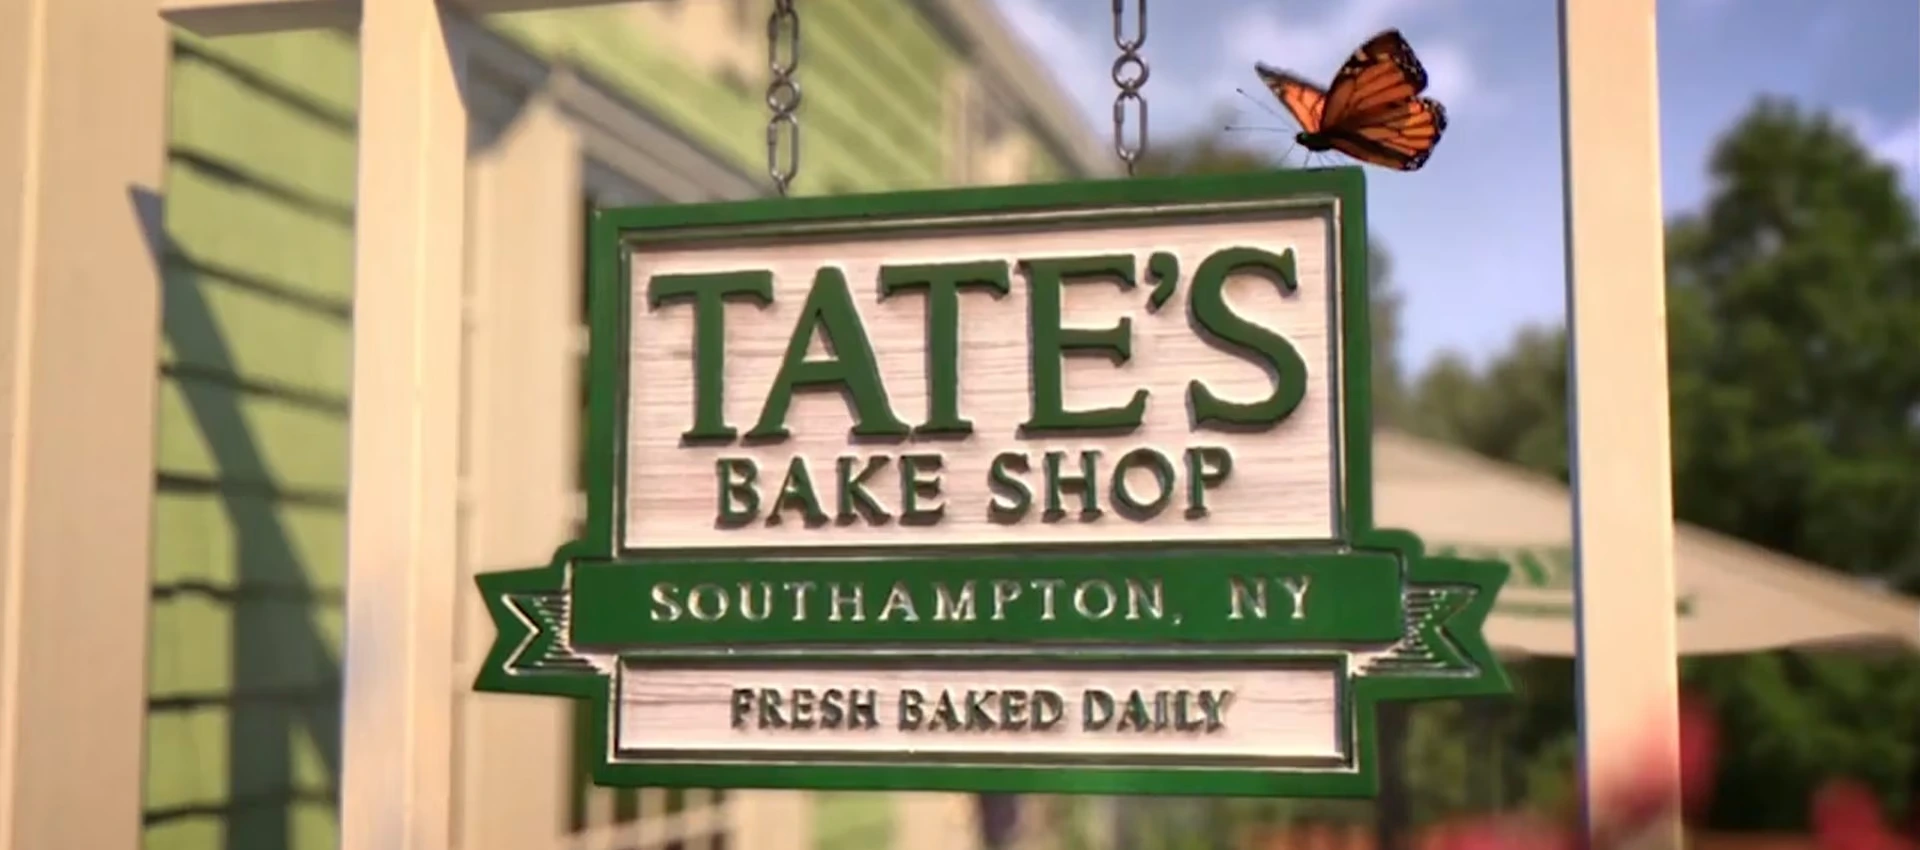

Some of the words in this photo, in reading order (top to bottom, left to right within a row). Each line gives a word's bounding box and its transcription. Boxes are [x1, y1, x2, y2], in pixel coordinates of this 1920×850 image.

[647, 246, 1308, 447] TATE'S
[714, 454, 946, 529] BAKE
[988, 445, 1232, 524] SHOP
[650, 577, 1184, 626] SOUTHAMPTON,
[1227, 576, 1313, 620] NY
[730, 687, 878, 731] FRESH
[898, 688, 1064, 732] BAKED
[1082, 687, 1235, 733] DAILY
